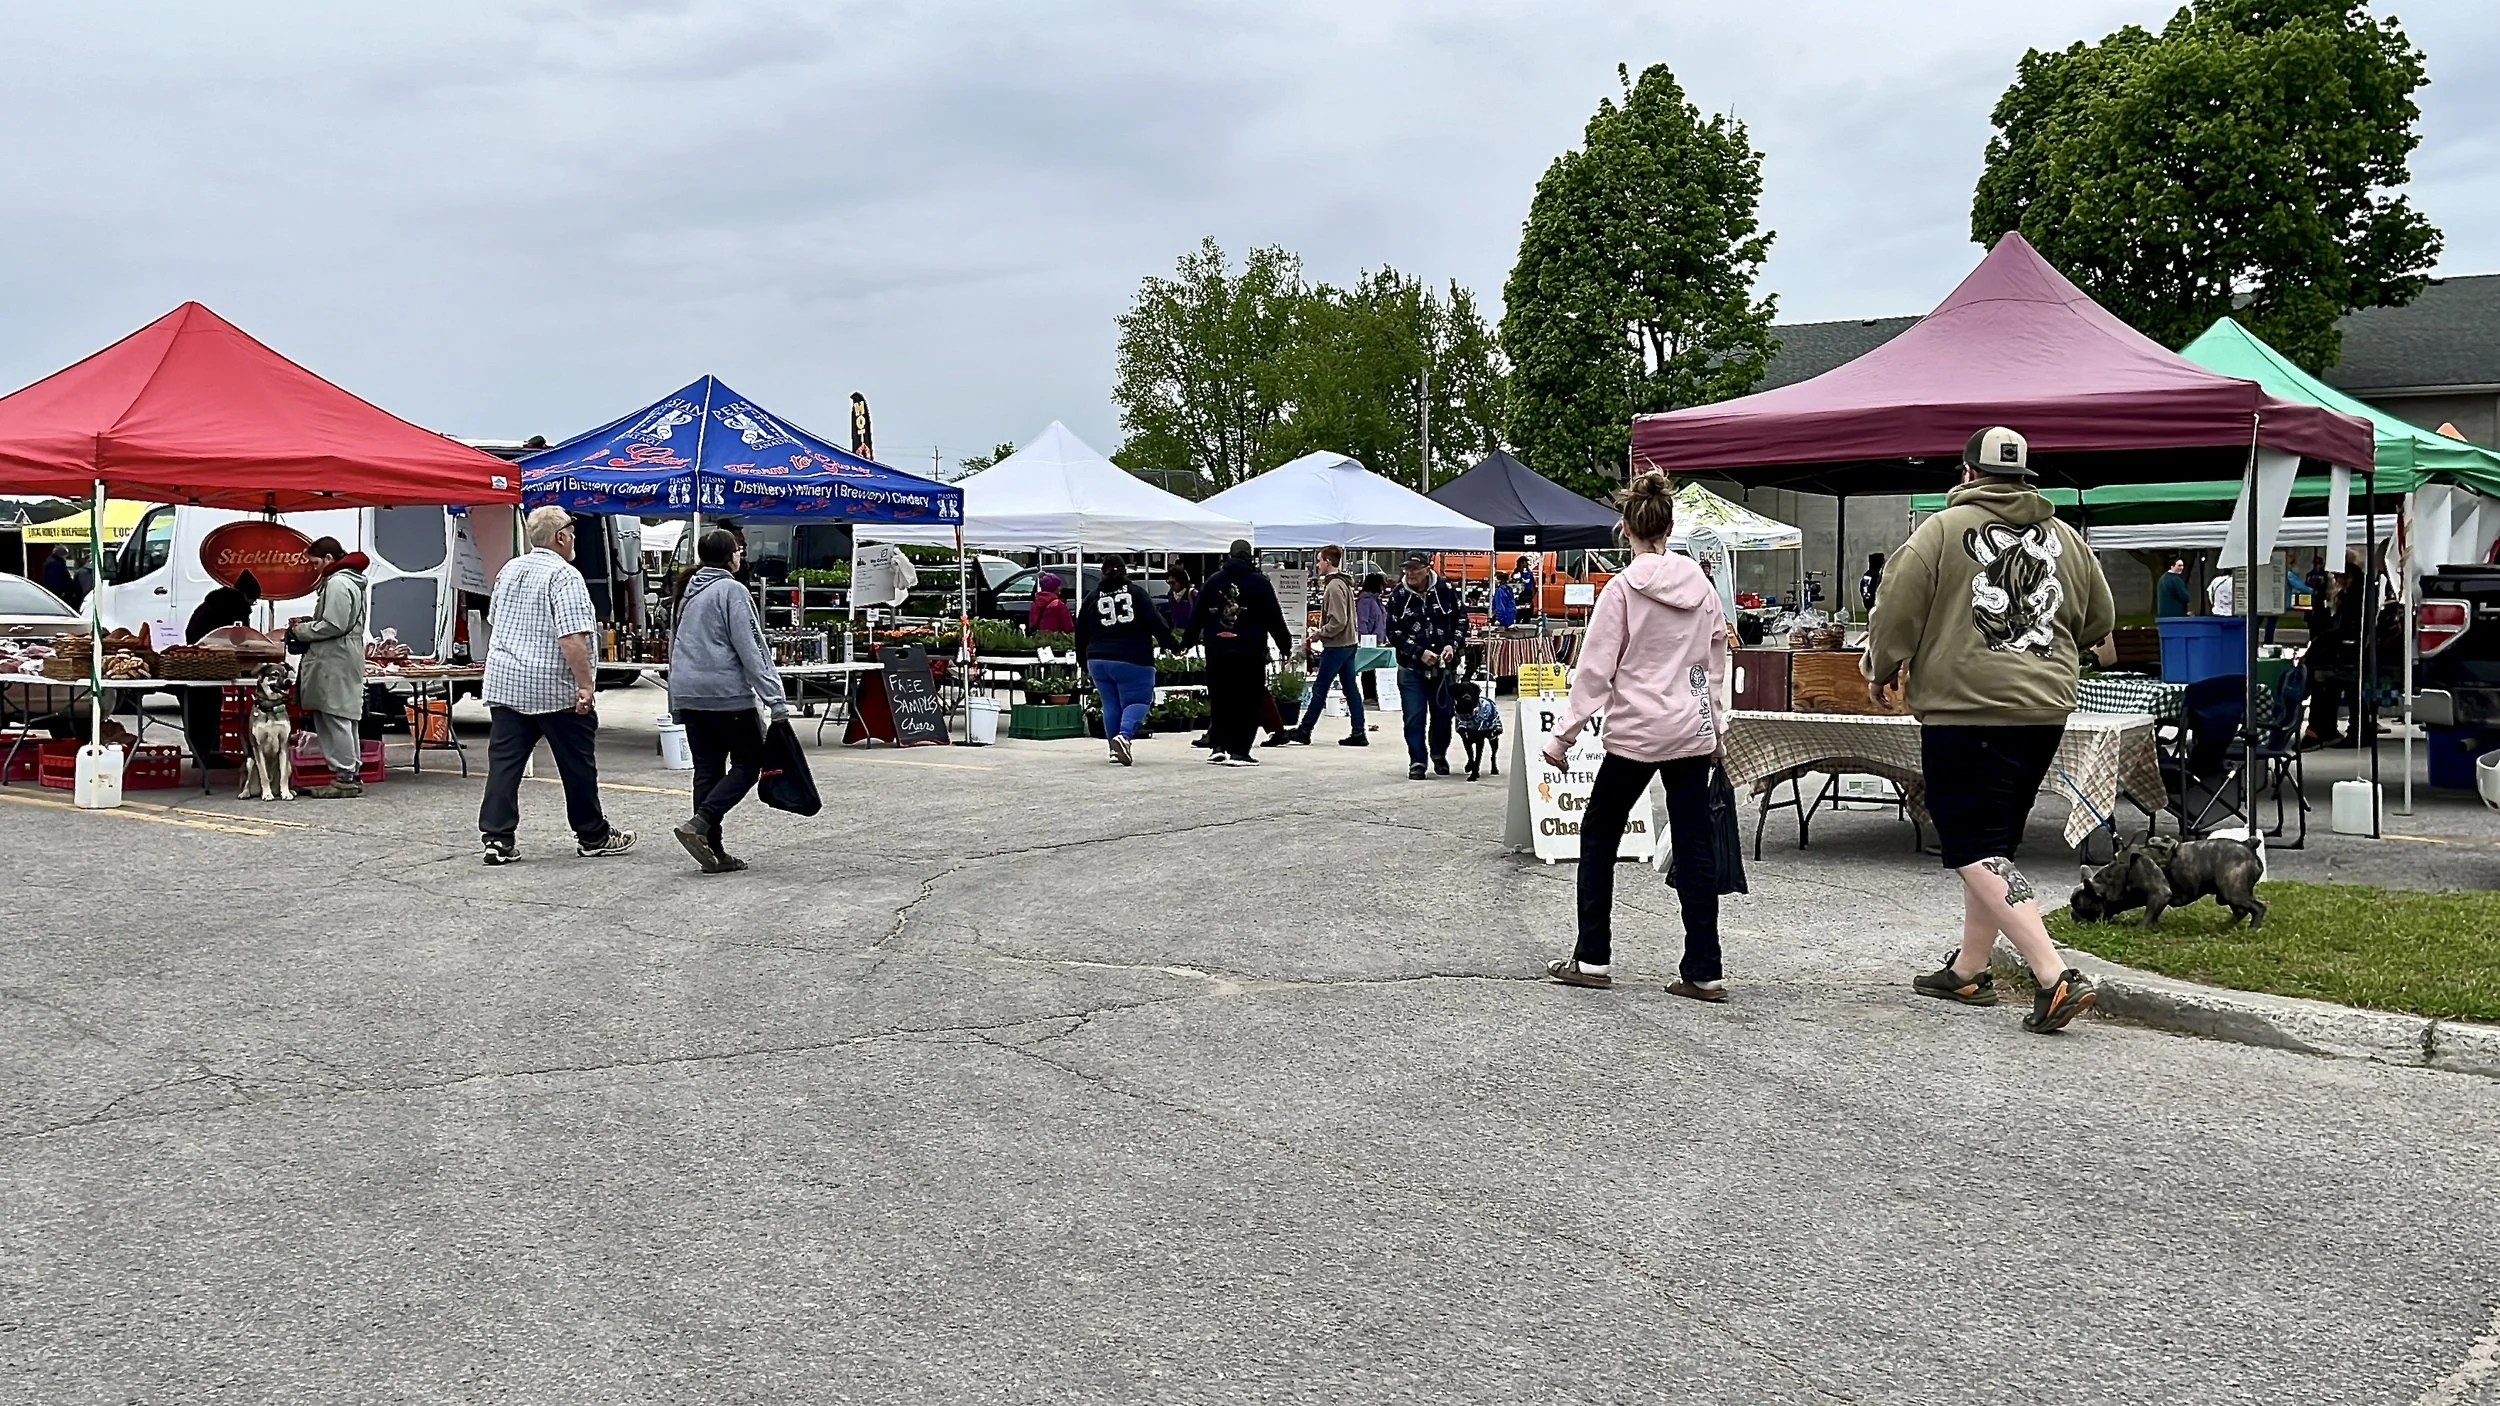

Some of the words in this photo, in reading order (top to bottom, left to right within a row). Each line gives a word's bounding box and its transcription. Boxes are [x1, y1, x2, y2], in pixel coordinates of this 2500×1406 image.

[733, 480, 786, 497] Distillery
[840, 484, 885, 504] Brewery
[217, 548, 310, 567] Sticklings
[1699, 551, 1722, 561] BIKE
[1097, 592, 1135, 627] 93
[888, 674, 924, 693] FREE
[893, 694, 938, 714] SAMPLES
[1543, 772, 1595, 784] BUTTER
